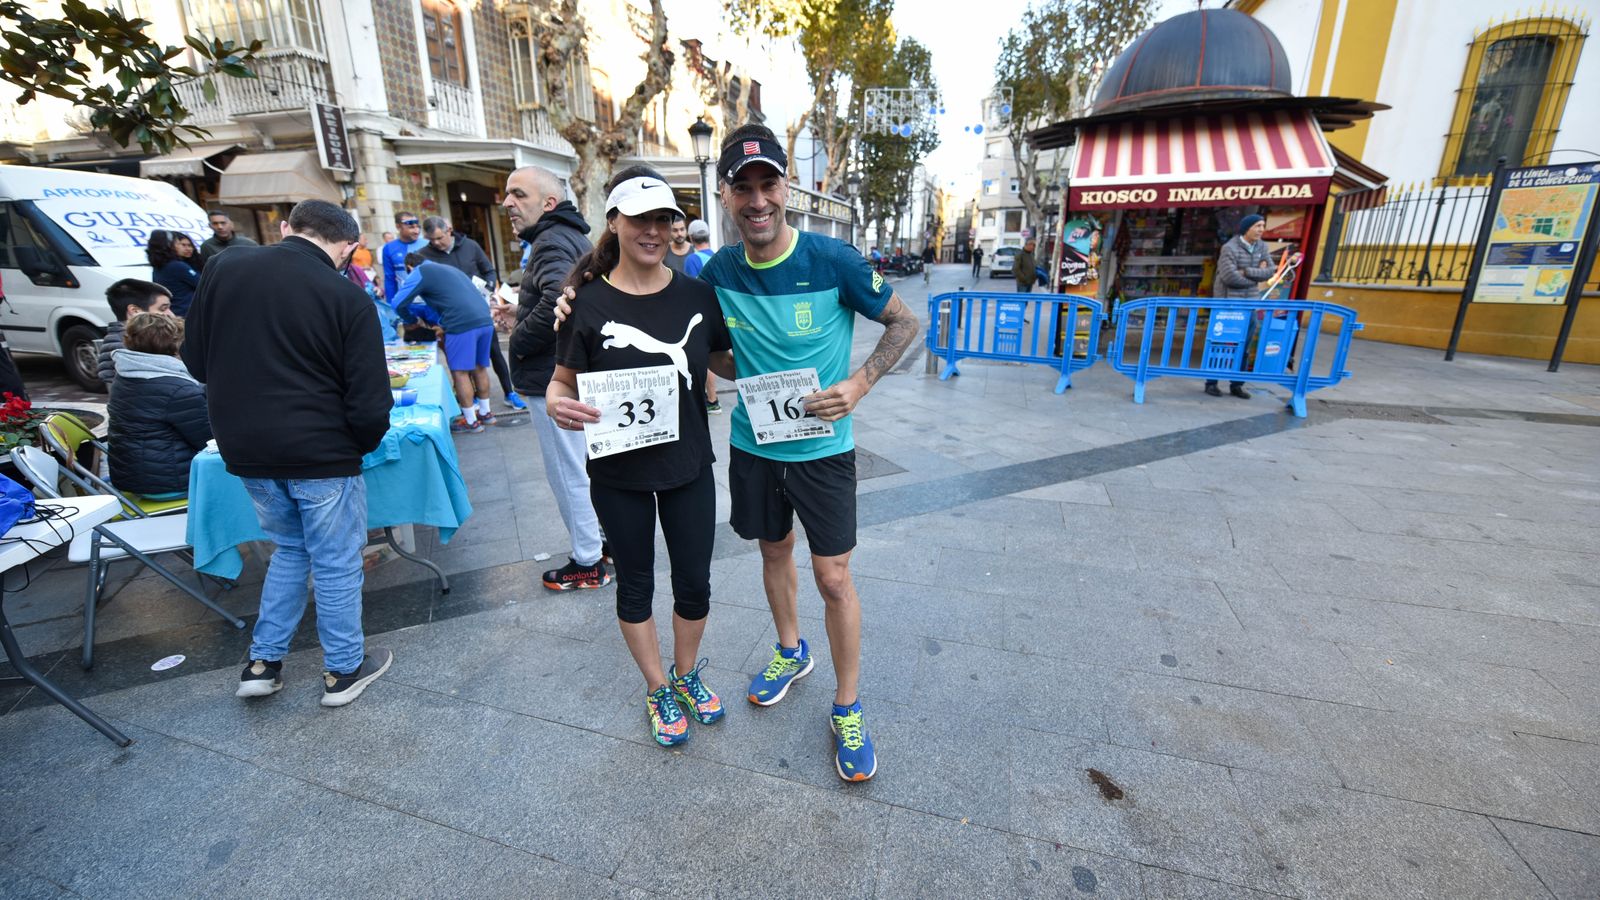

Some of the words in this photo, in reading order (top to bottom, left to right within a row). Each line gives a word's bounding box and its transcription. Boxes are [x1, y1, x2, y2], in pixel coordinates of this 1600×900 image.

[1508, 179, 1521, 187] DE
[1521, 178, 1533, 187] LA
[1510, 171, 1522, 179] LA
[1080, 188, 1157, 205] KIOSCO
[1168, 184, 1313, 203] INMACULADA
[618, 398, 656, 428] 33
